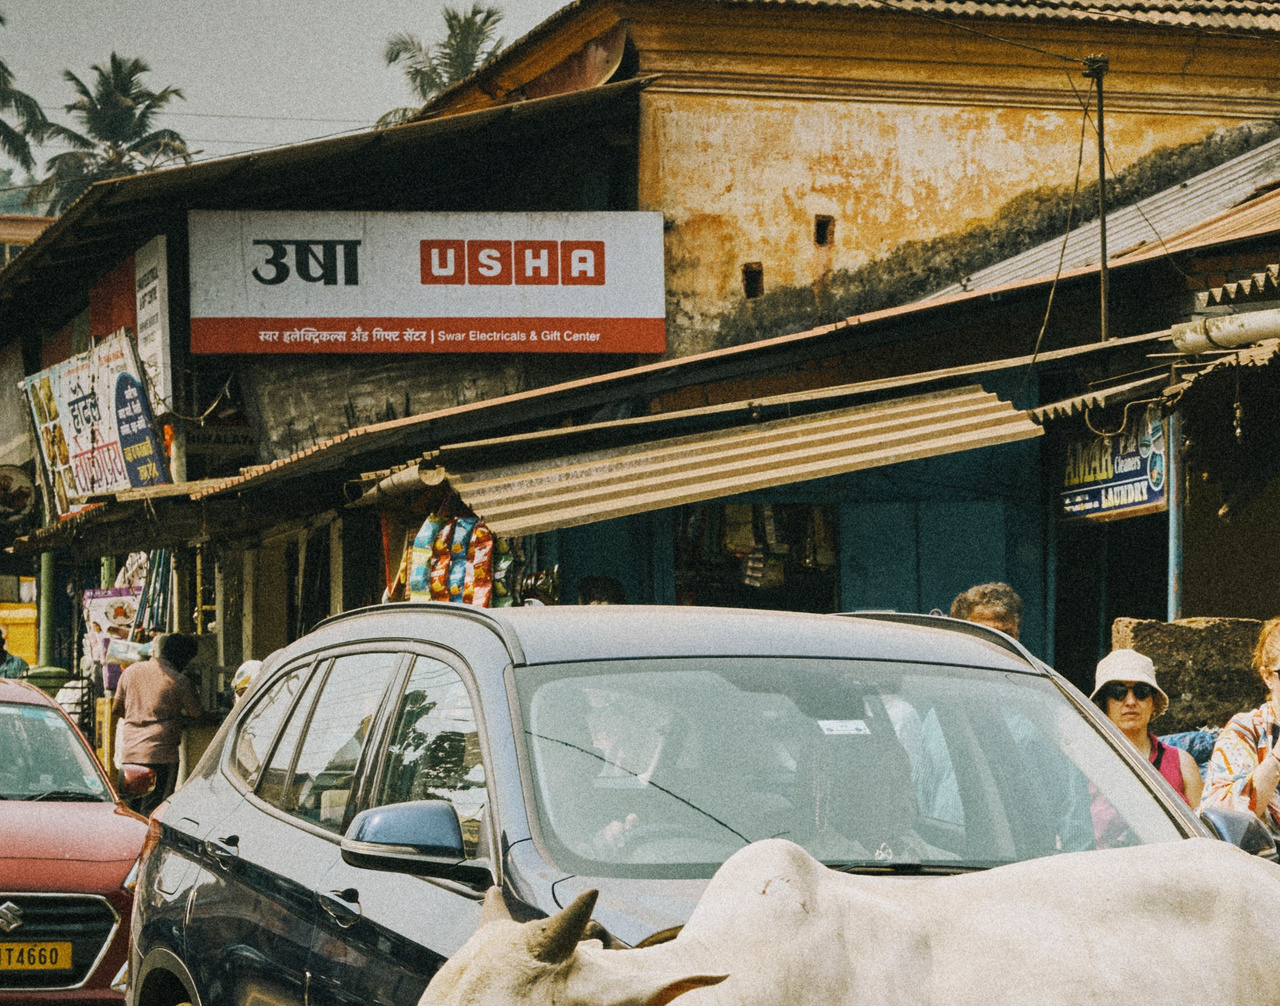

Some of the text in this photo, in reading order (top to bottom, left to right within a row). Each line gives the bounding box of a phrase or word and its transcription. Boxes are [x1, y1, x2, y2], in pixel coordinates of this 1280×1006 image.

[252, 239, 361, 286] उषा
[428, 246, 597, 279] USHA
[259, 330, 279, 342] स्वर
[372, 328, 400, 342] गिफ्ट
[437, 330, 601, 341] Swar Electricals & Gift Center
[1101, 481, 1148, 509] LAUNDRY
[0, 946, 58, 966] T4660
